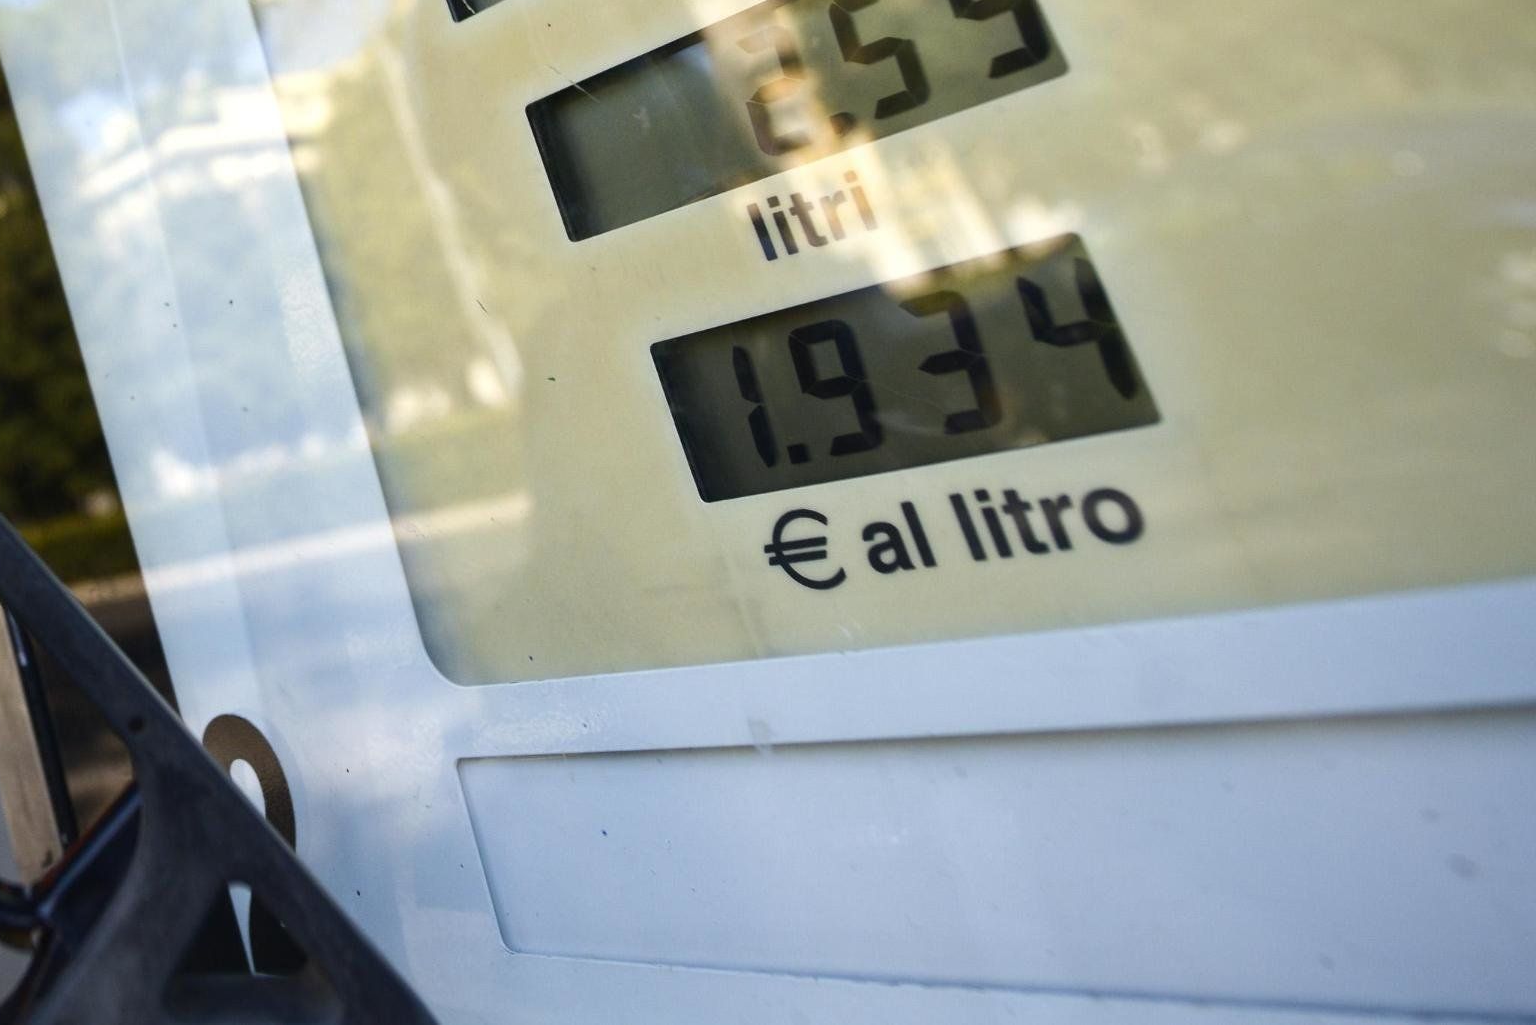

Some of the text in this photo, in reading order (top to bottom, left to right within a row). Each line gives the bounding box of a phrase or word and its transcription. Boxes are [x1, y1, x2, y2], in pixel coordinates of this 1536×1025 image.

[746, 170, 879, 262] litri
[731, 256, 1140, 470] 1.934
[764, 486, 1146, 591] € al litro
